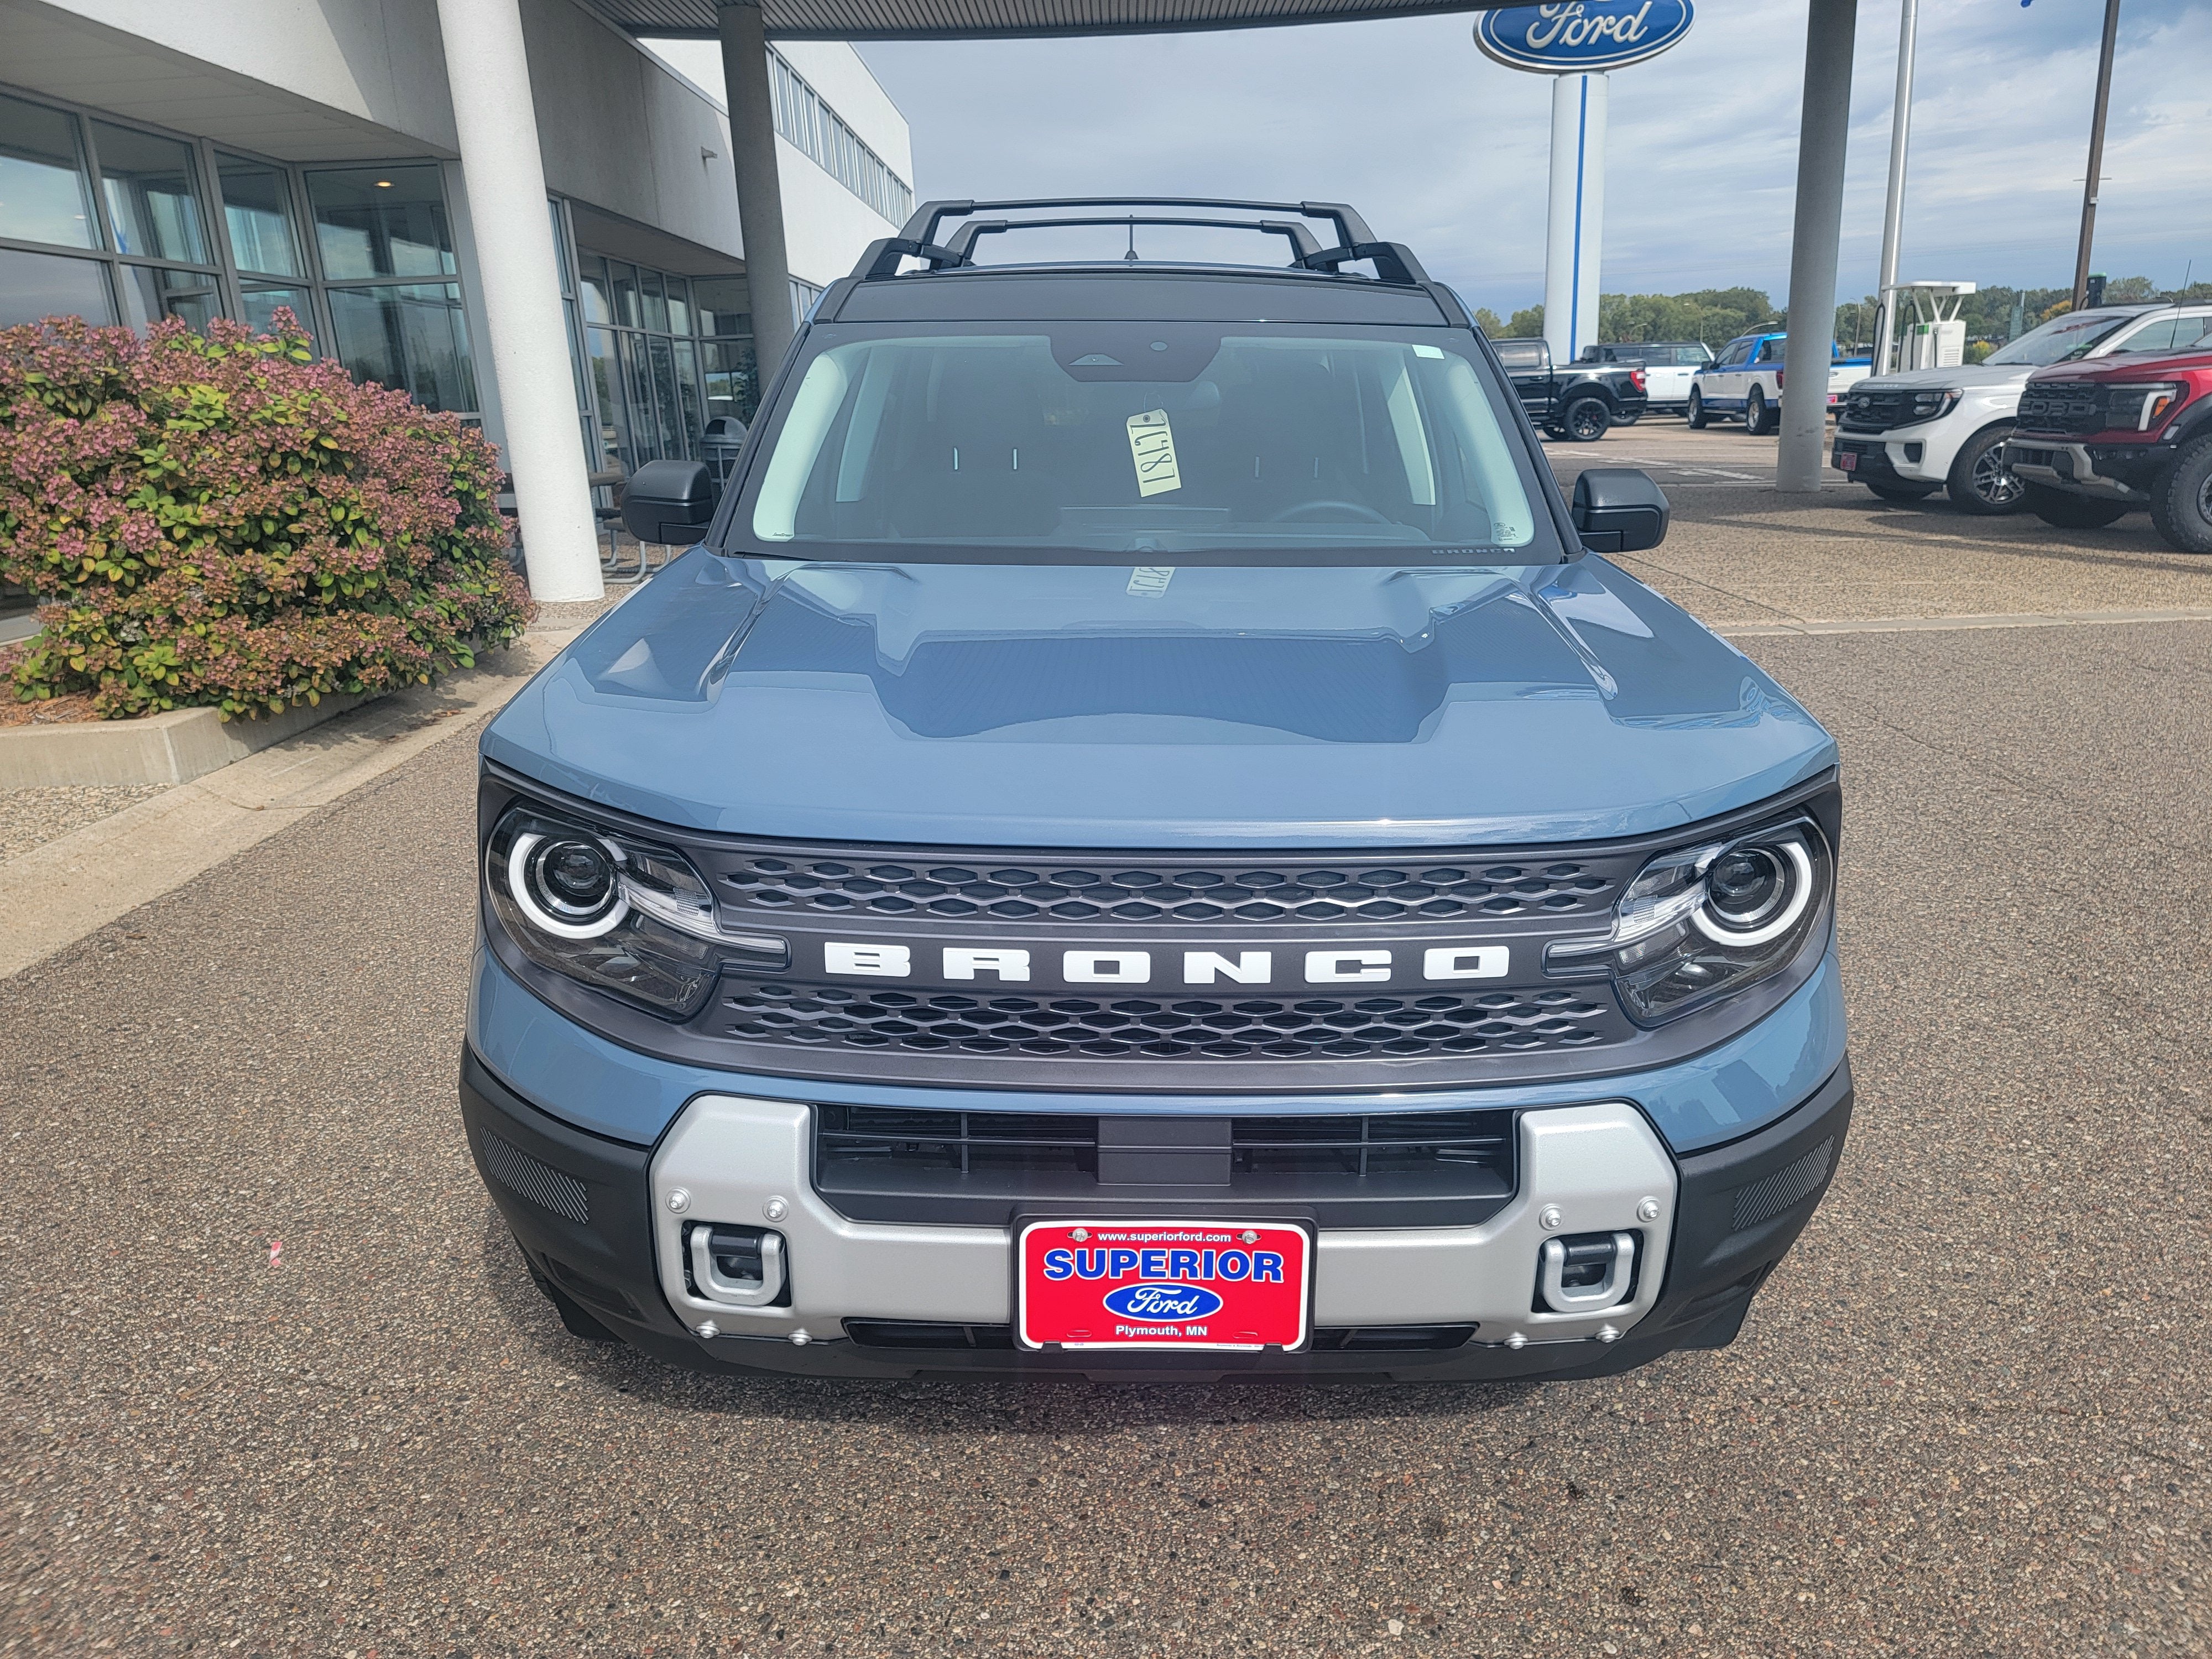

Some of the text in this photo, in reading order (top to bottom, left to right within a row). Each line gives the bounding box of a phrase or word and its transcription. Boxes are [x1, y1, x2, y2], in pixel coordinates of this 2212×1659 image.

[1526, 0, 1652, 49] Ford
[824, 942, 1510, 983] BRONCO
[1098, 1232, 1231, 1243] www.superiorford.com
[1044, 1248, 1285, 1283] SUPERIOR
[1126, 1287, 1199, 1314] Ford
[1115, 1326, 1207, 1337] Plymouth, MN
